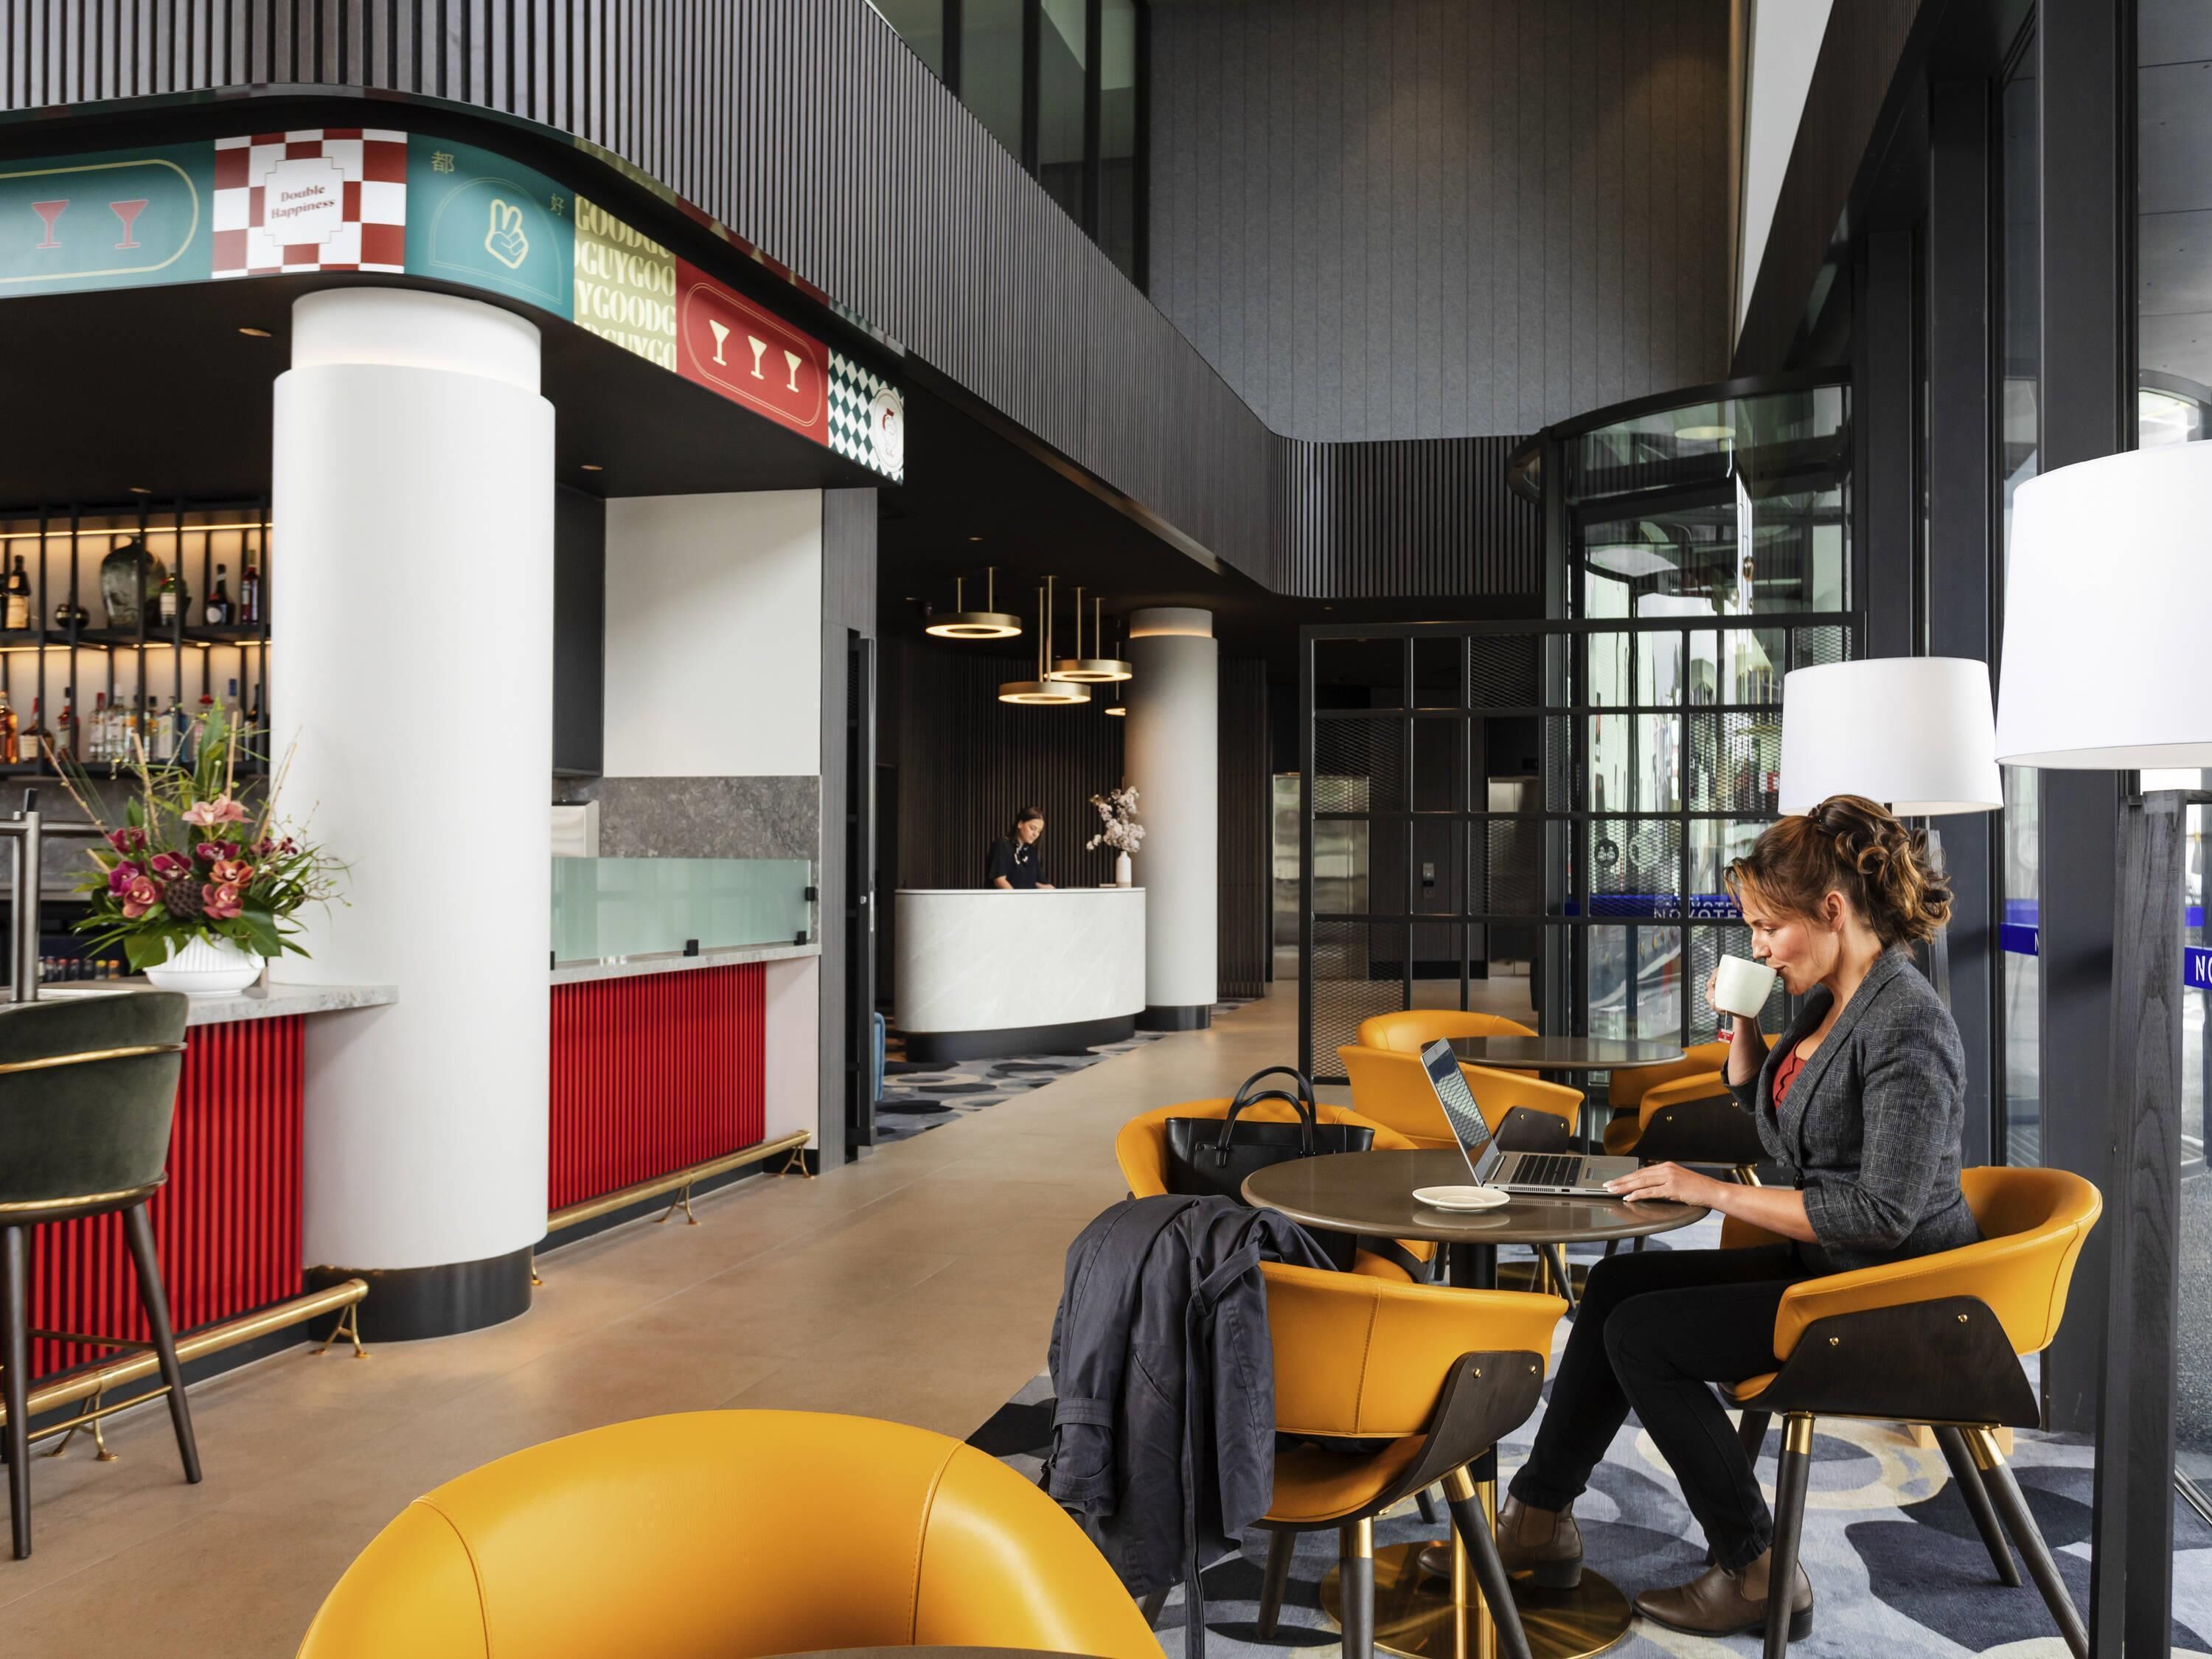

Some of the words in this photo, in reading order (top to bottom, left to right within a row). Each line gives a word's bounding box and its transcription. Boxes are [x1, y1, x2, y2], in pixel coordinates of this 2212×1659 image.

[431, 151, 454, 174] 都
[280, 185, 325, 202] Double
[550, 192, 564, 216] 好
[271, 199, 335, 219] Happiness
[575, 195, 671, 258] GOOD
